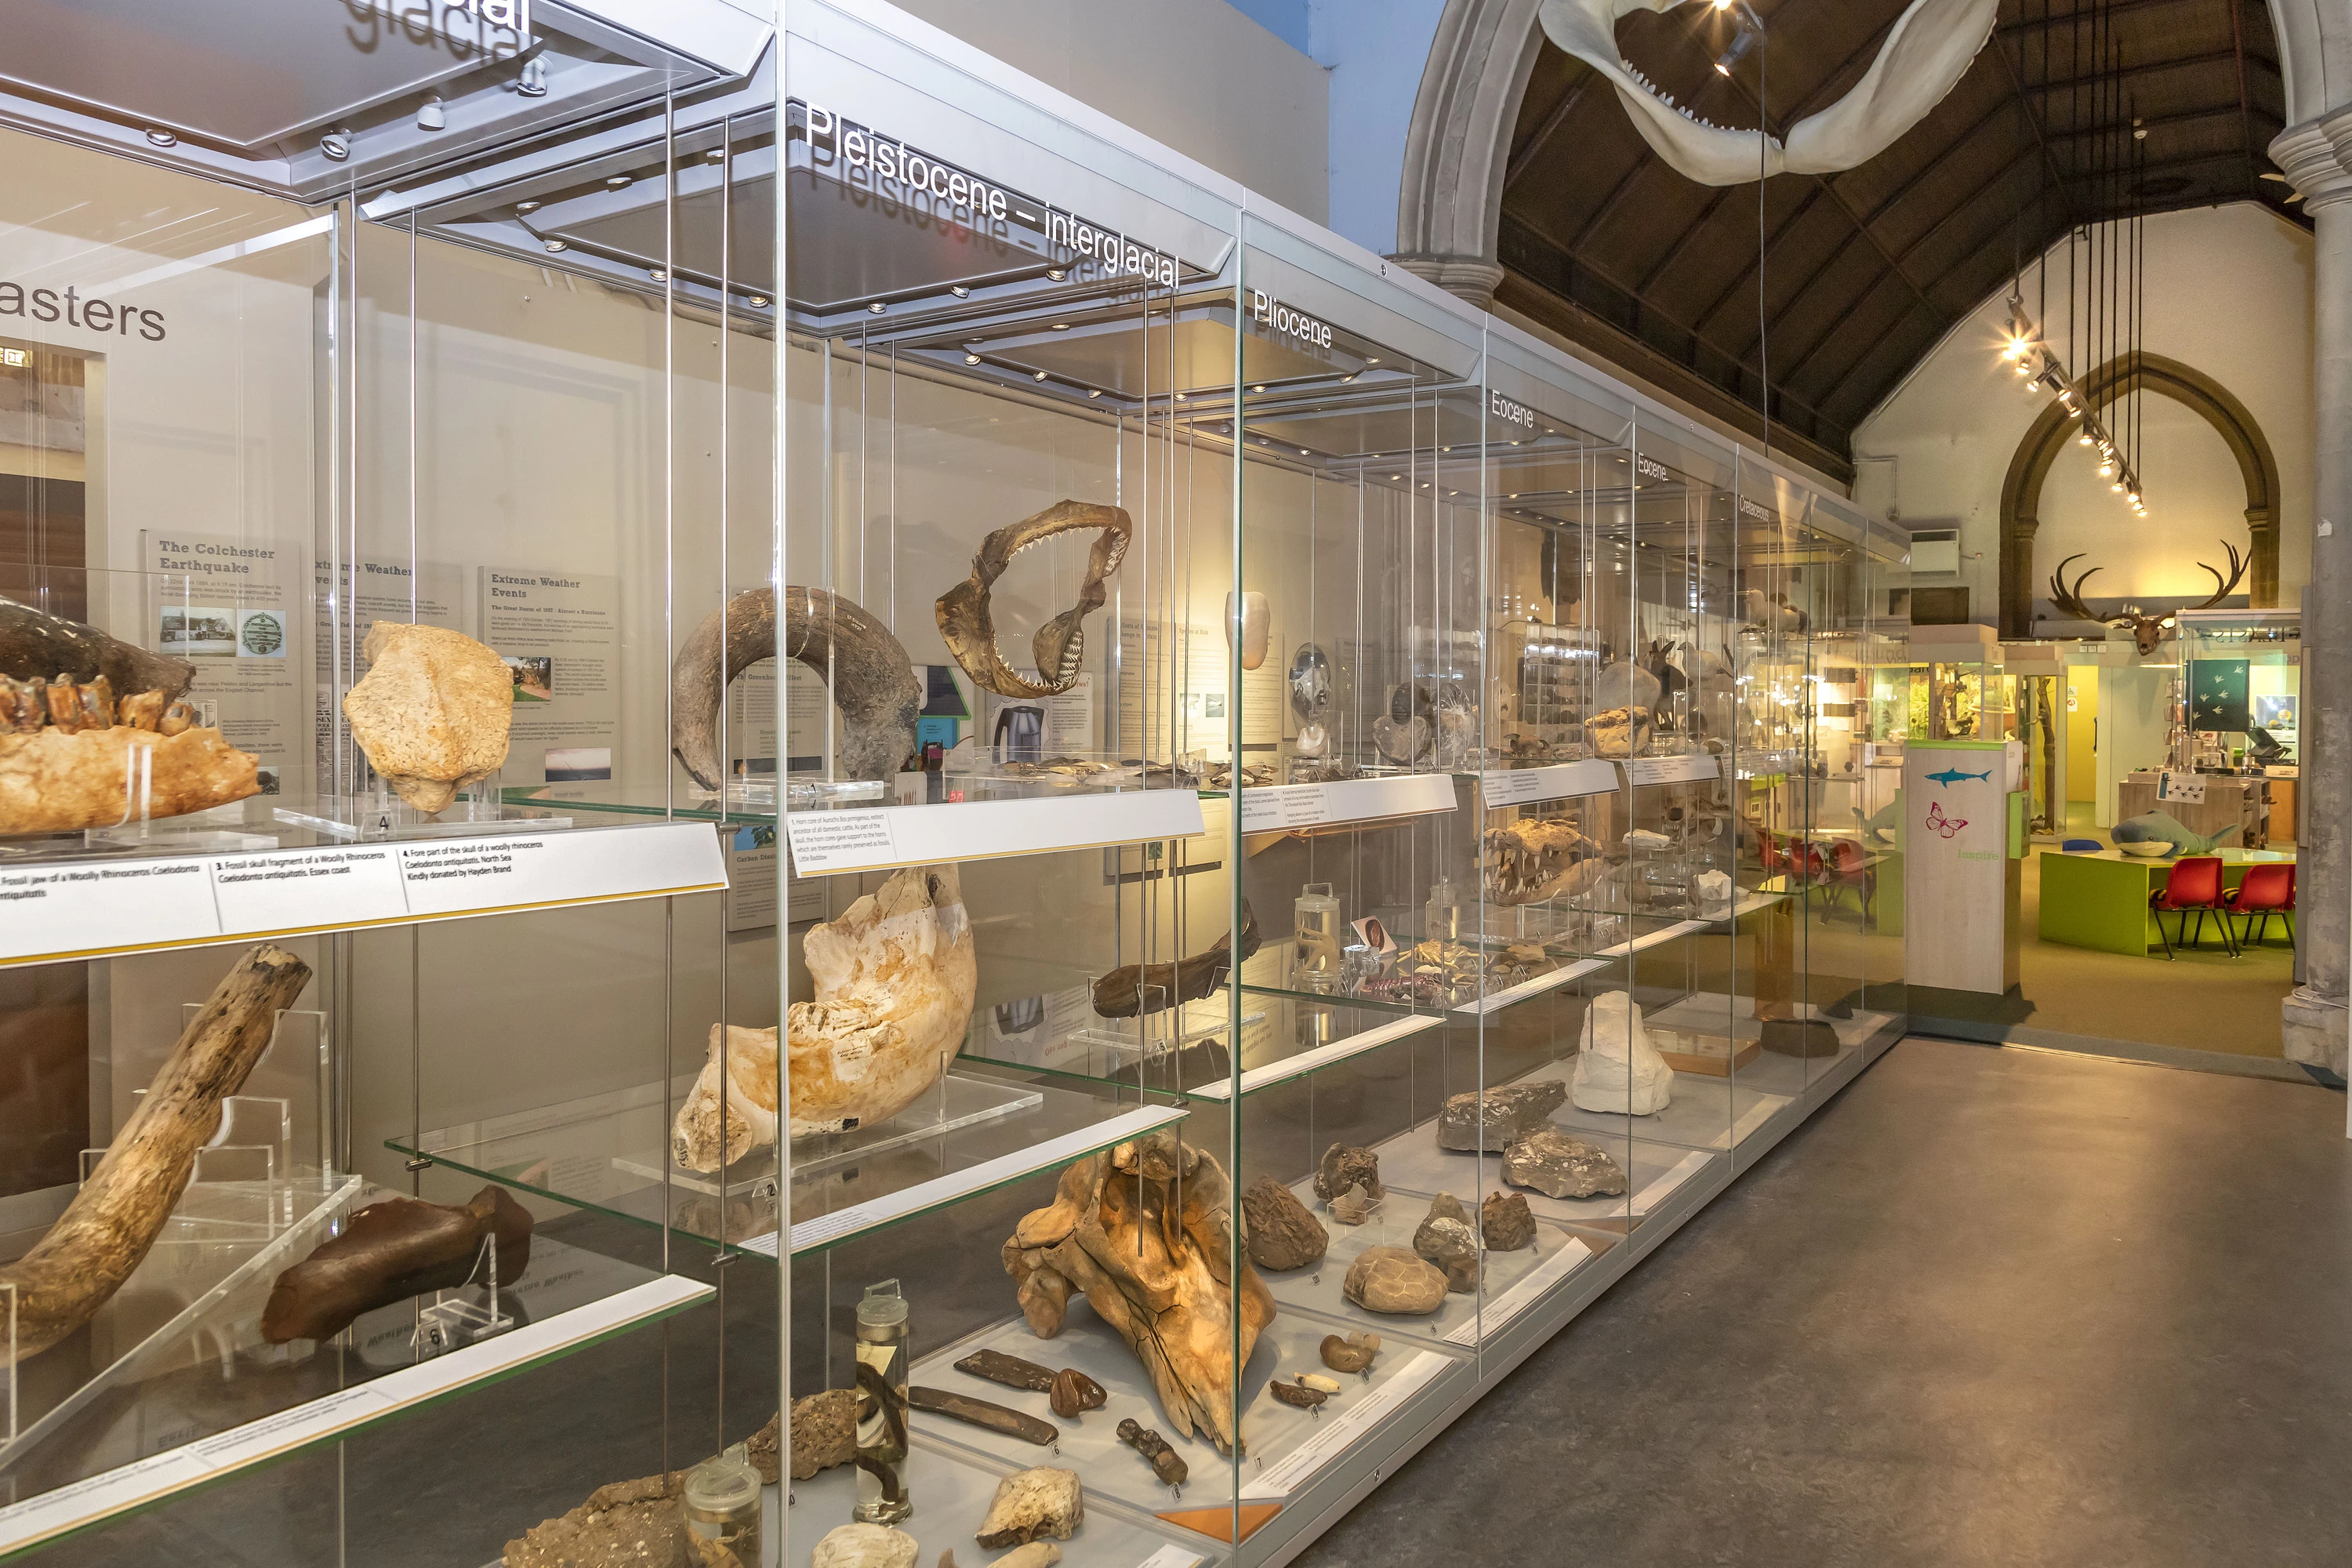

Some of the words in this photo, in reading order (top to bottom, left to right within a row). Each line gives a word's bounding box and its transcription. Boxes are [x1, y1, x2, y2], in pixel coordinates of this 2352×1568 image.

[805, 101, 1007, 220] Pleistocene
[1045, 201, 1179, 289] interglacial
[0, 281, 166, 342] asters
[1254, 289, 1331, 349] Pliocene
[1492, 392, 1534, 429] Eocene
[1638, 452, 1667, 481] Eocene
[1740, 495, 1769, 521] Cretaceous
[159, 540, 189, 554] The
[195, 543, 275, 559] Colchester
[160, 557, 249, 575] Earthquake
[492, 574, 536, 586] Extreme
[539, 577, 580, 588] Weather
[492, 587, 527, 598] Events
[379, 816, 389, 829] 4
[426, 848, 441, 857] part
[490, 843, 510, 851] woolly
[511, 841, 543, 850] rhinoceros
[225, 861, 247, 869] Fossil
[249, 859, 267, 868] skull
[268, 857, 303, 868] fragment
[305, 855, 313, 864] of
[320, 854, 344, 864] Woolly
[346, 851, 386, 861] Rhinoceros
[49, 874, 59, 883] of
[101, 868, 151, 879] Rhinoceros
[310, 867, 329, 876] Essex
[407, 872, 428, 881] Kindly
[430, 869, 457, 879] donated
[458, 869, 466, 878] by
[468, 866, 492, 876] Hayden
[493, 865, 511, 873] Brand
[430, 1329, 440, 1345] 6
